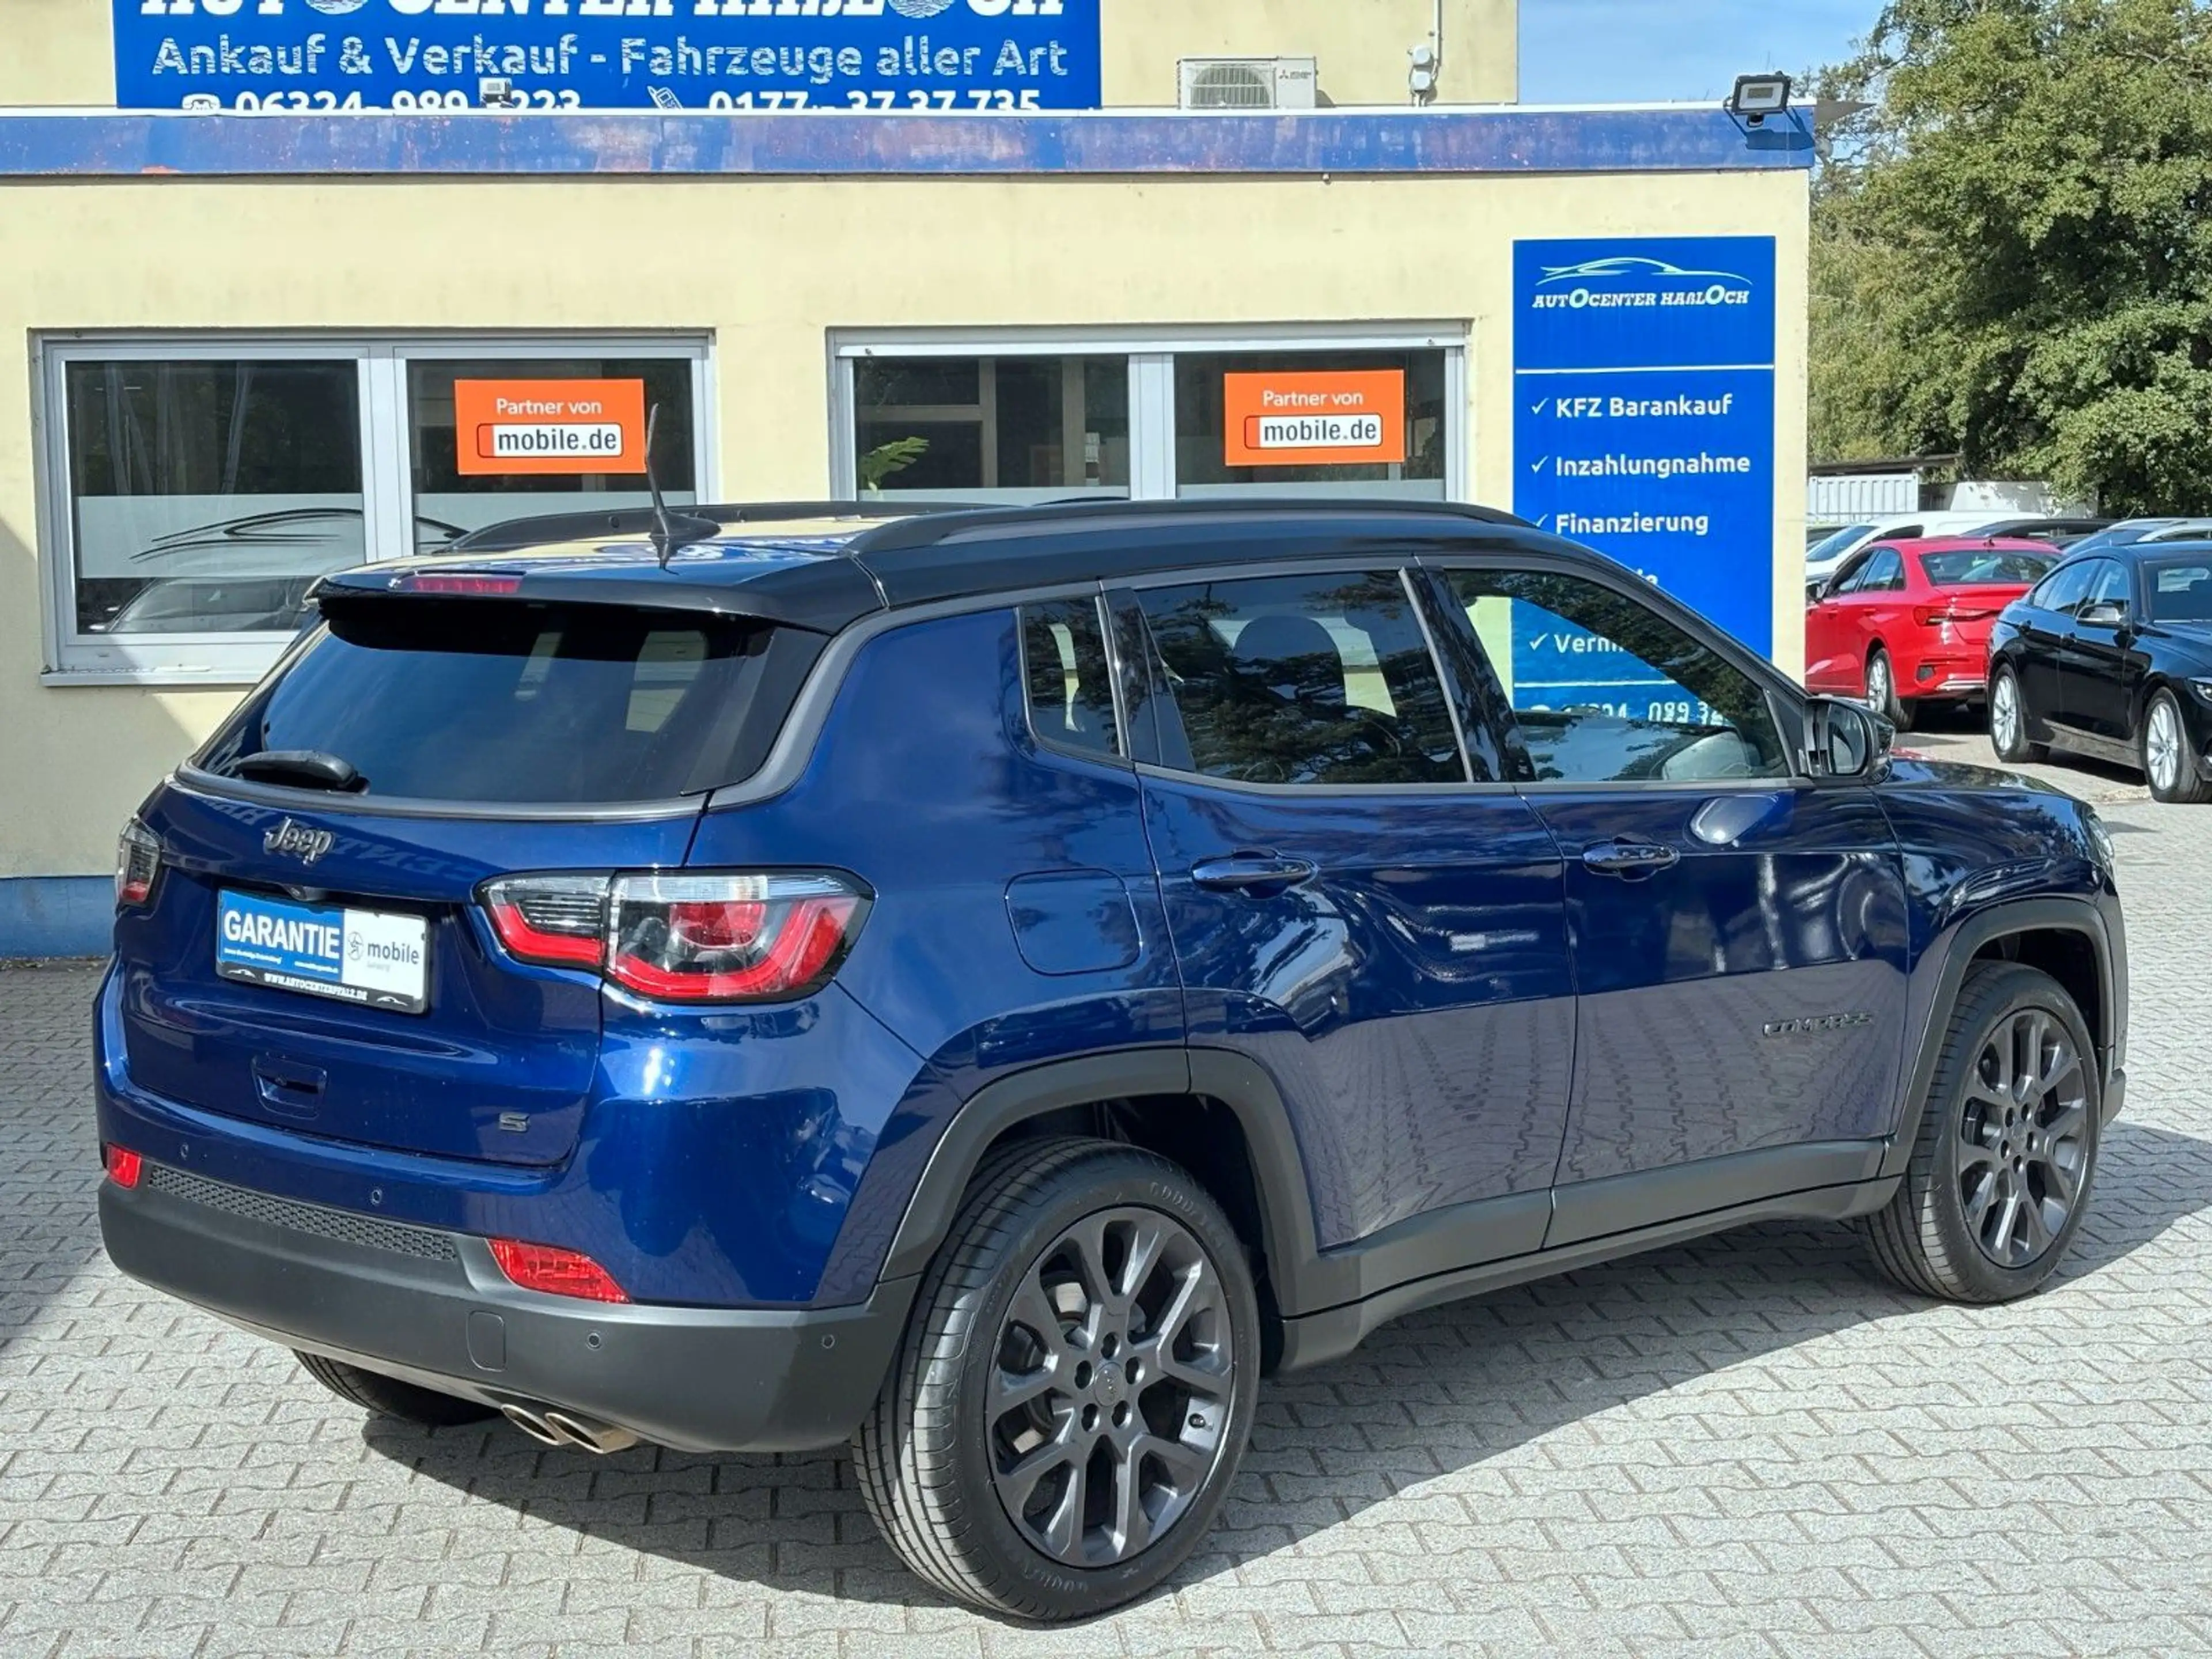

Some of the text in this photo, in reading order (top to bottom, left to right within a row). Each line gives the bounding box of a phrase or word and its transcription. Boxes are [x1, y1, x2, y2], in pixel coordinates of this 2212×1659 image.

[152, 33, 326, 75] Ankauf
[339, 36, 373, 75] &
[384, 33, 578, 75] Verkauf
[620, 36, 862, 85] Fahrzeuge
[876, 35, 980, 76] aller
[993, 39, 1069, 76] Art
[1532, 288, 1657, 309] AUTOCENTER
[496, 397, 602, 415] Partner von
[1263, 389, 1363, 407] Partner von
[1556, 393, 1733, 418] KFZ Barankauf
[498, 428, 617, 451] mobile.de
[1264, 419, 1376, 442] mobile.de
[1556, 452, 1751, 479] Inzahlungnahme
[1556, 512, 1709, 535] Finanzierung
[263, 816, 334, 864] Jeep
[224, 910, 340, 960] GARANTIE
[367, 941, 421, 965] mobile
[499, 1111, 530, 1133] S
